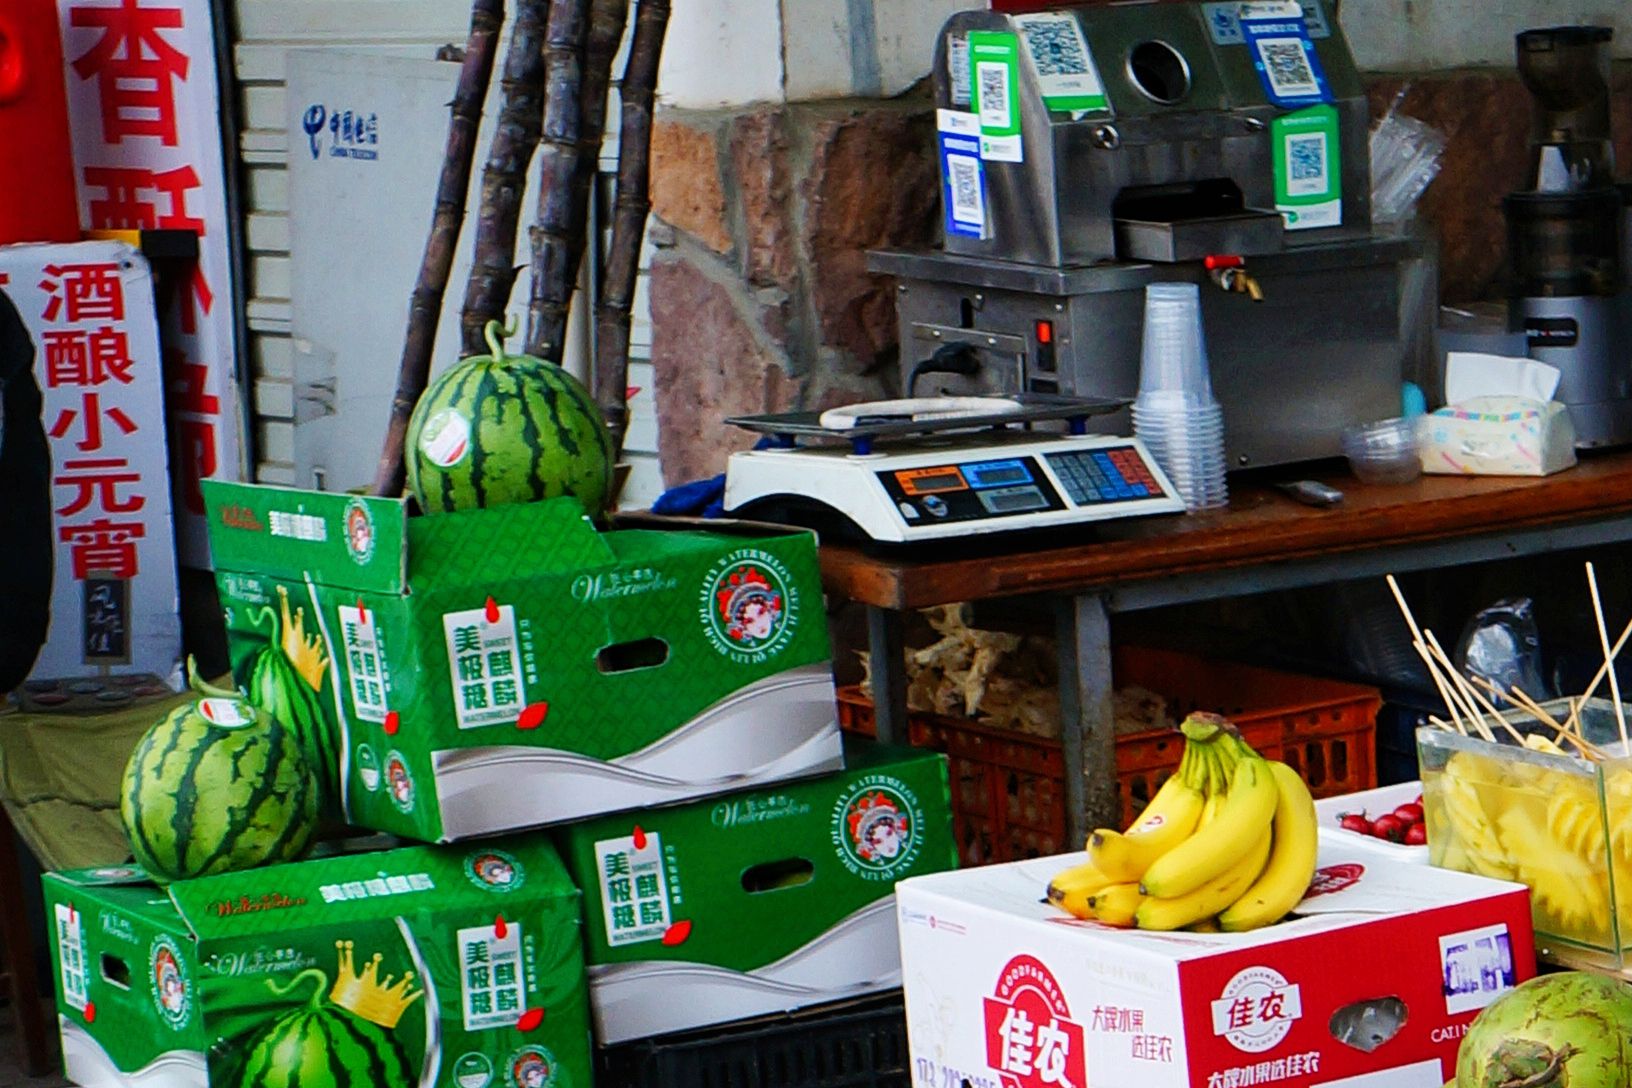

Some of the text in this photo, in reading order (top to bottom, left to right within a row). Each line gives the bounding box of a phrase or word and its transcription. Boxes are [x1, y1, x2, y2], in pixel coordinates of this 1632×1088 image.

[38, 263, 146, 580] 酒酿小元宵
[1092, 1005, 1144, 1033] 大牌水果
[1227, 990, 1288, 1030] 佳农
